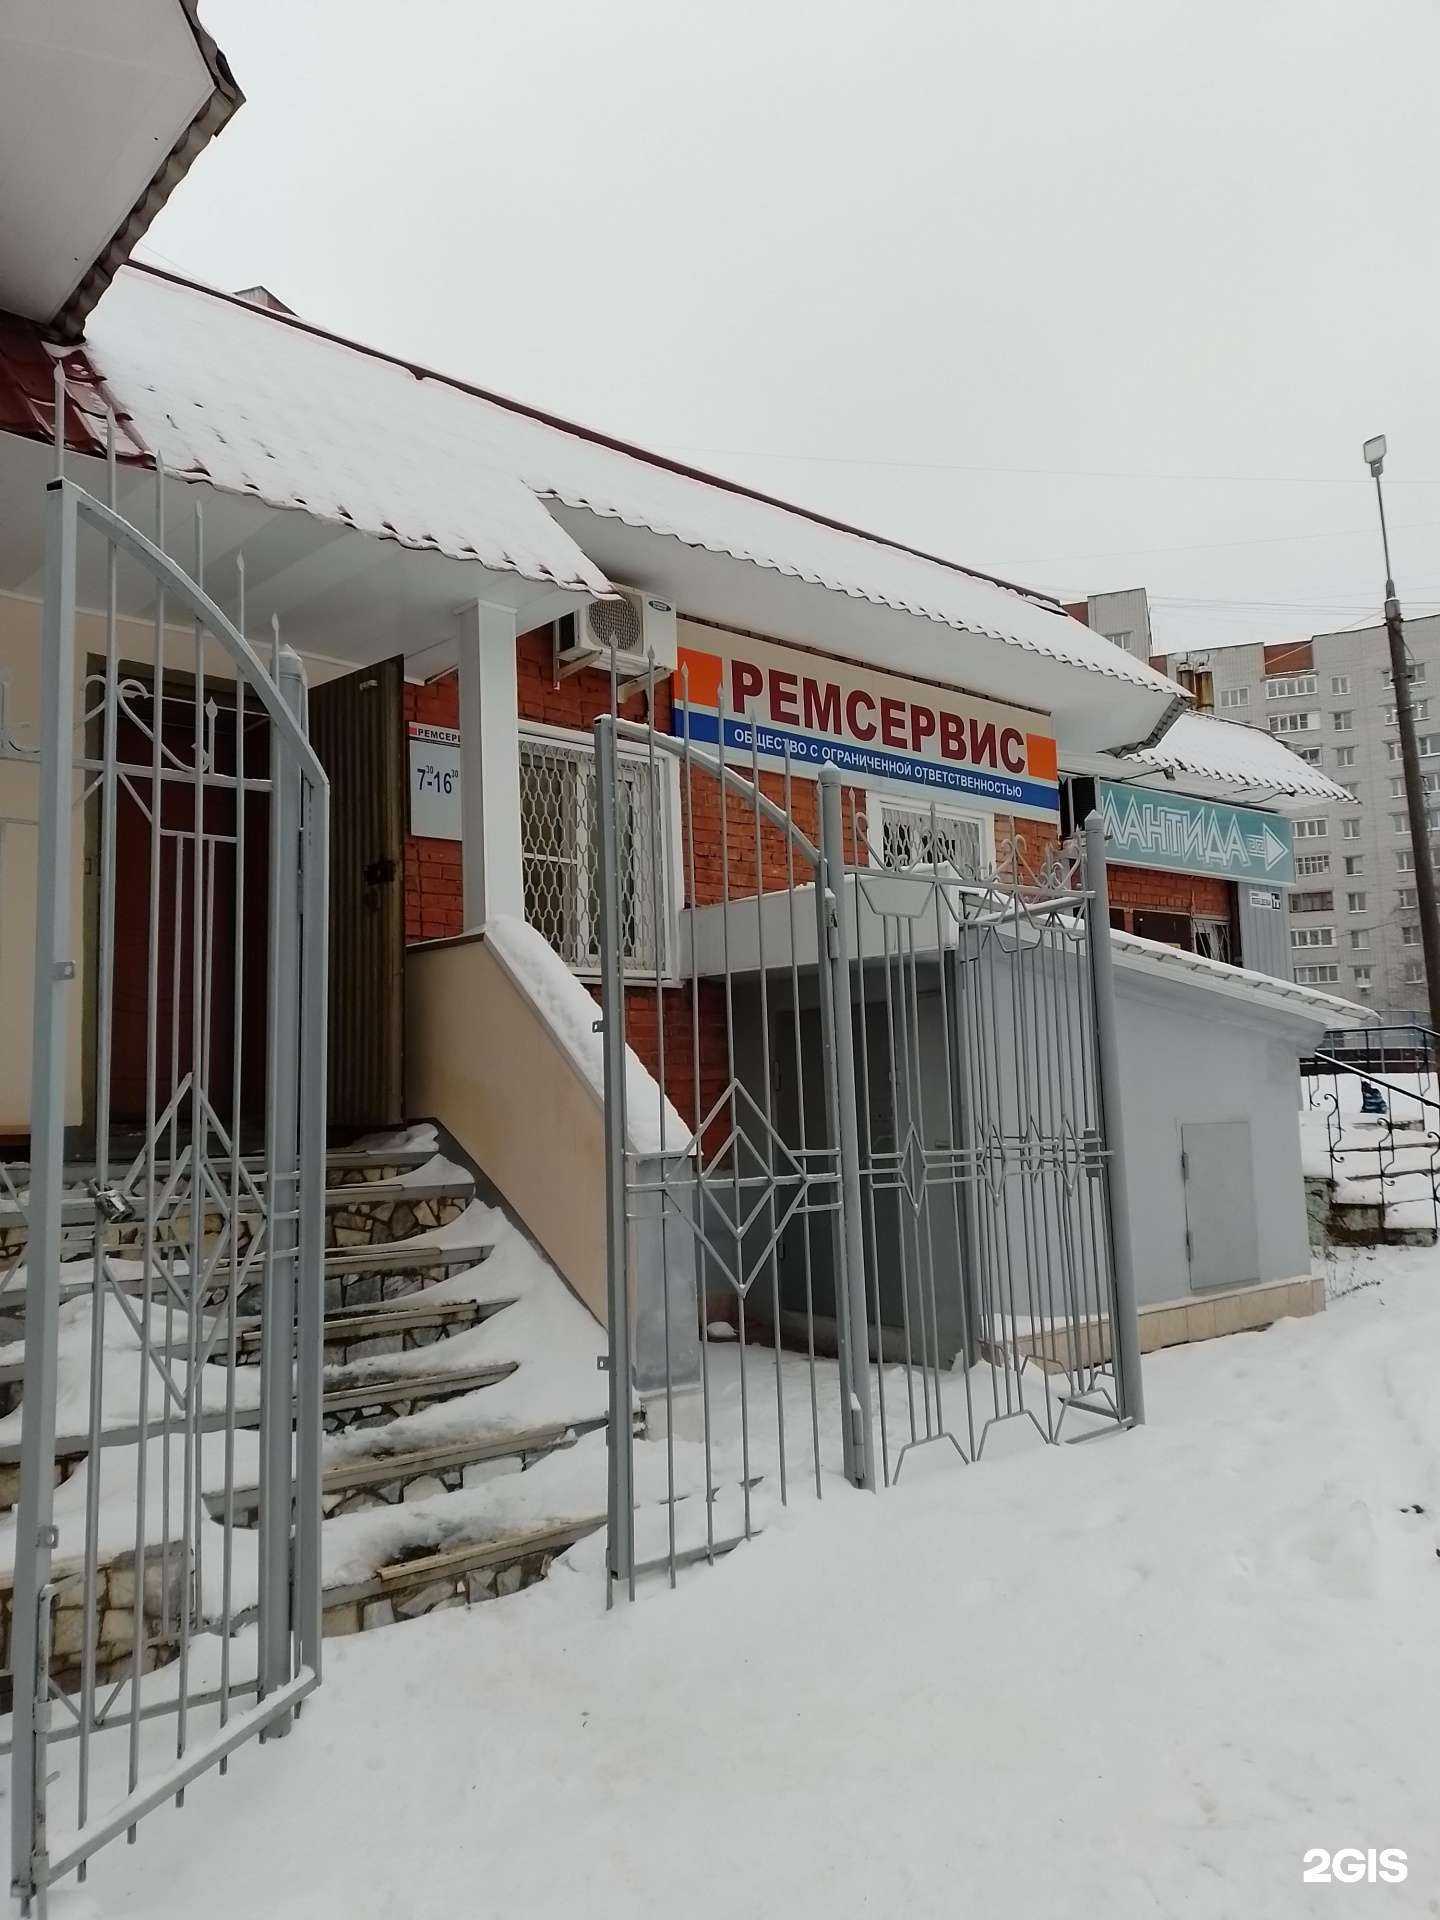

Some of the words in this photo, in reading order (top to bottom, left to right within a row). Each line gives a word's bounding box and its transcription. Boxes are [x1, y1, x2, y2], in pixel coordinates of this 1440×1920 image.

[731, 659, 1026, 775] РЕМСЕРВИС
[810, 744, 818, 758] С
[821, 746, 912, 776] ОГРАНИЧЕННОЙ
[914, 766, 1022, 798] ОТВЕТСТВЕННОСТЬЮ
[1101, 789, 1251, 867] ЛАНТИДА
